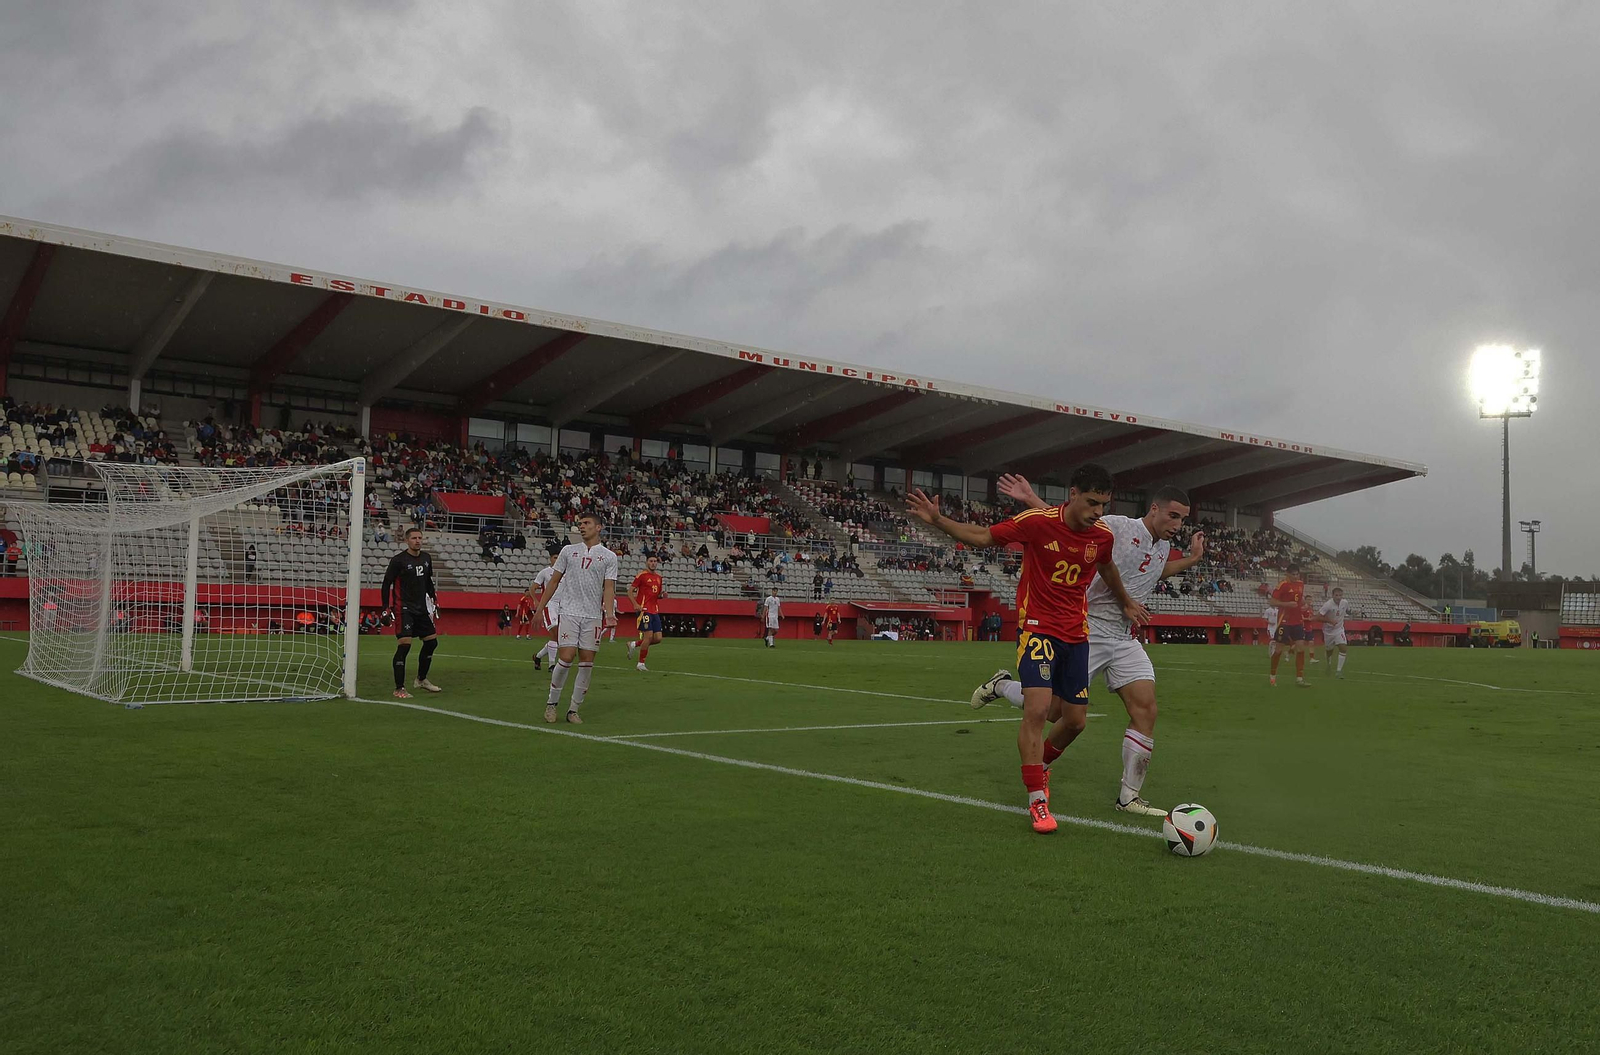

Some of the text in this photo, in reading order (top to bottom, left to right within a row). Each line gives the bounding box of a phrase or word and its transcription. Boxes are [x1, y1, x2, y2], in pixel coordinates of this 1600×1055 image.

[290, 272, 1313, 453] ESTADIO MUNICIPAL NUEVO MIRADOR
[580, 556, 593, 570] 17
[1138, 553, 1151, 573] 2
[415, 565, 425, 577] 12
[1051, 560, 1081, 585] 20
[1294, 593, 1299, 602] 6
[642, 615, 650, 623] 19
[1279, 627, 1284, 635] 6
[1028, 637, 1055, 661] 20
